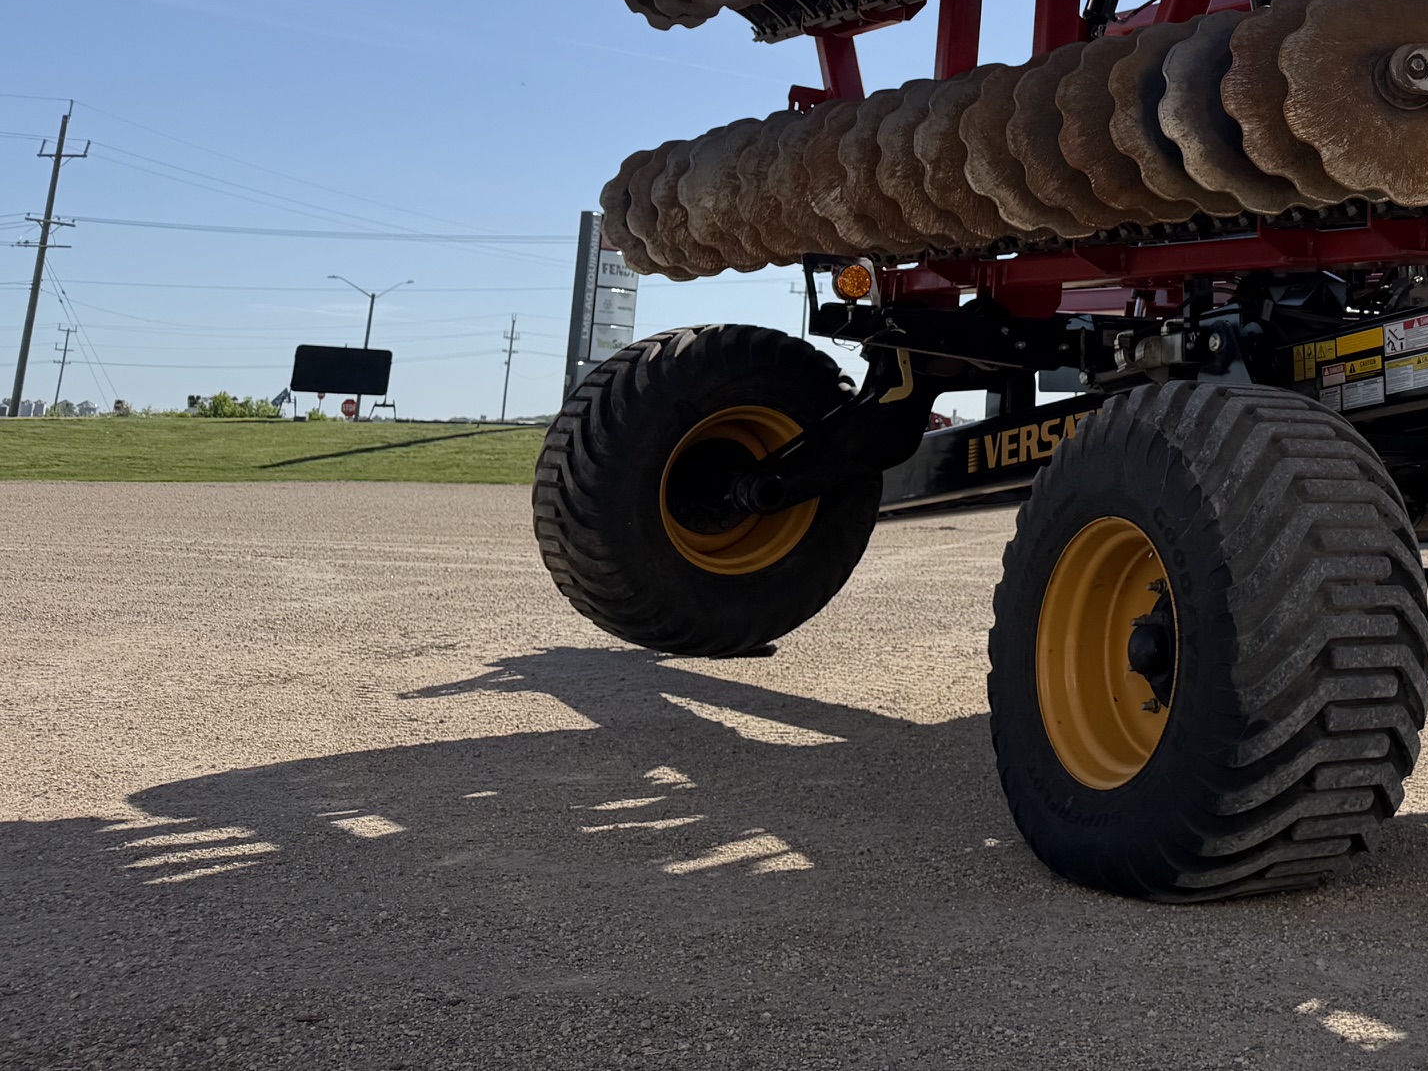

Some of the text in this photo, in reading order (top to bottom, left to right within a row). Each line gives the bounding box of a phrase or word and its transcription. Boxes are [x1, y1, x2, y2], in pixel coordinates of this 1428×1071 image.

[587, 219, 600, 291] EQUIPMENT
[1360, 359, 1377, 367] CAUTION
[342, 403, 356, 412] STOP
[984, 408, 1103, 469] VERSA
